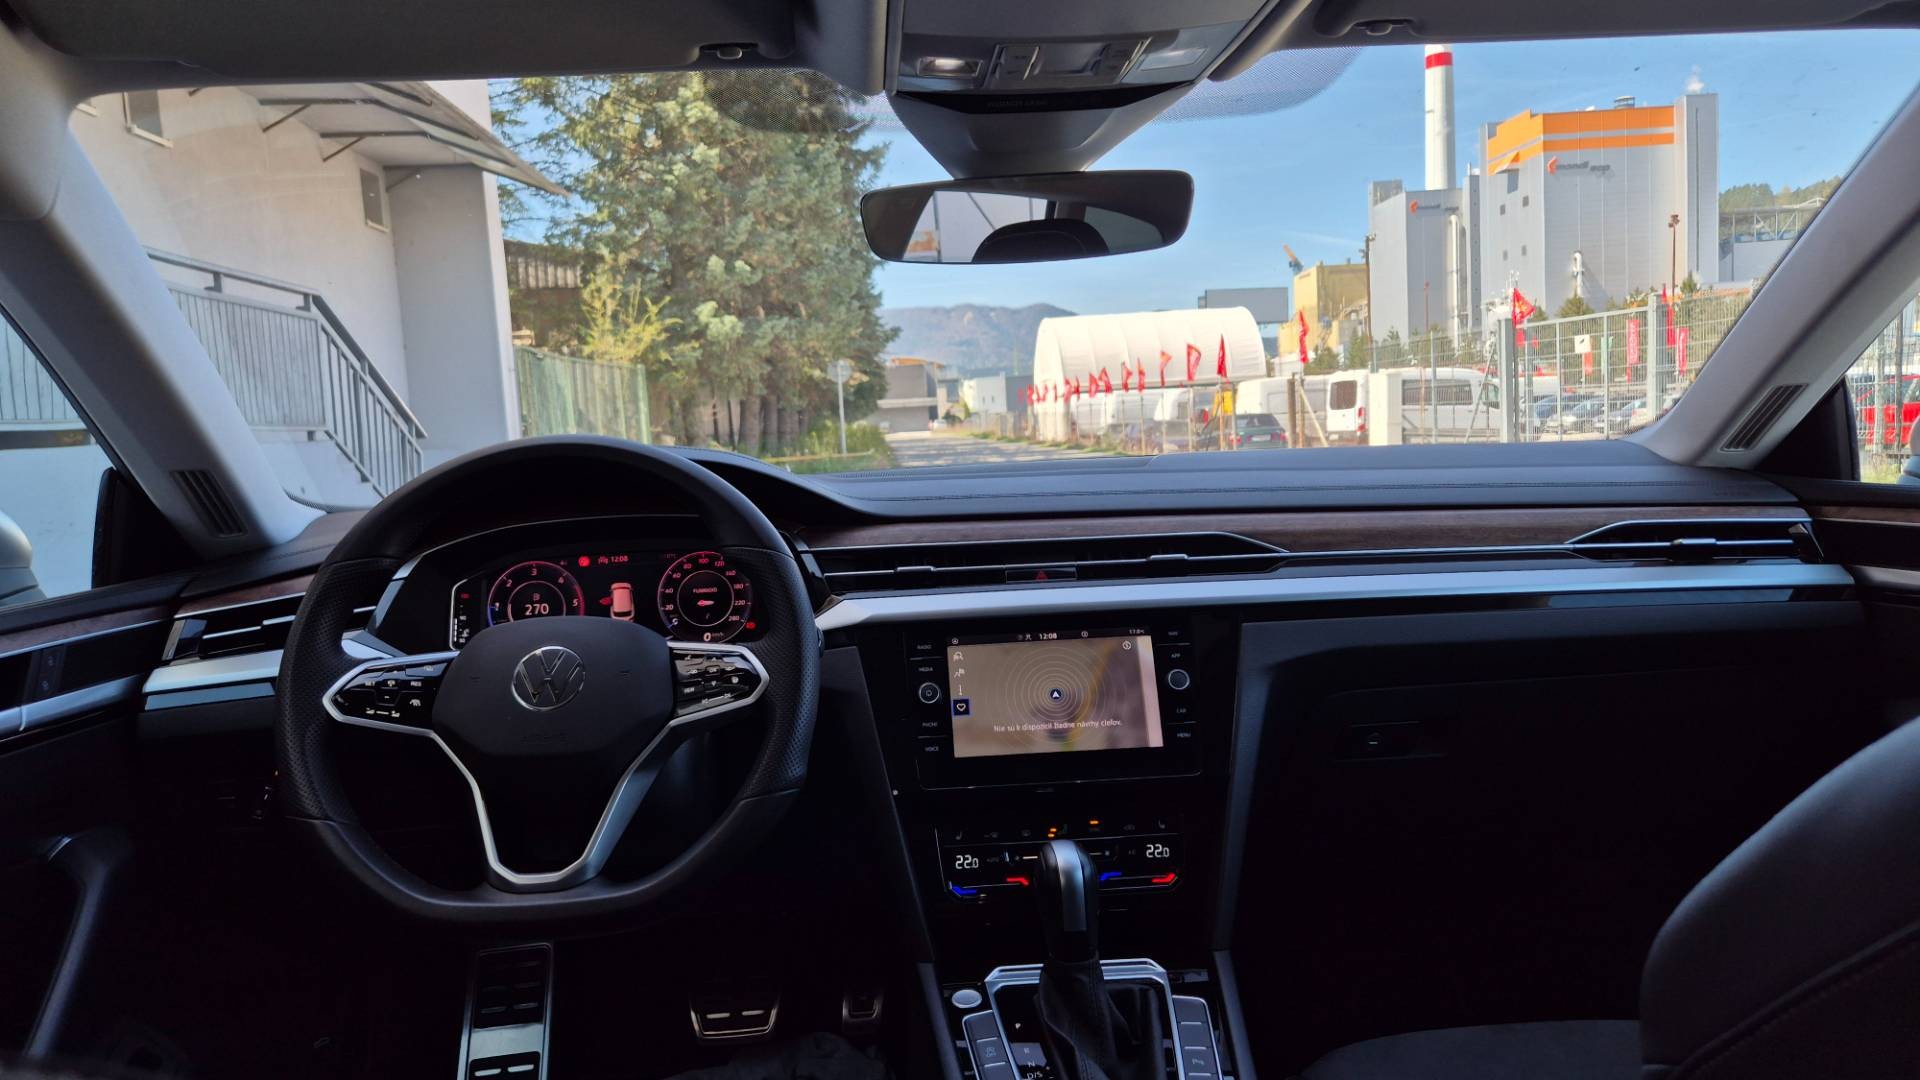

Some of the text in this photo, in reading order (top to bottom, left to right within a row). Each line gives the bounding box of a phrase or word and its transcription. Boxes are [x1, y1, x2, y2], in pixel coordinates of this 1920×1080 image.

[530, 568, 538, 576] 3
[506, 579, 513, 588] 2
[525, 603, 550, 616] 270
[703, 632, 712, 642] 0
[1038, 632, 1058, 640] 12:08
